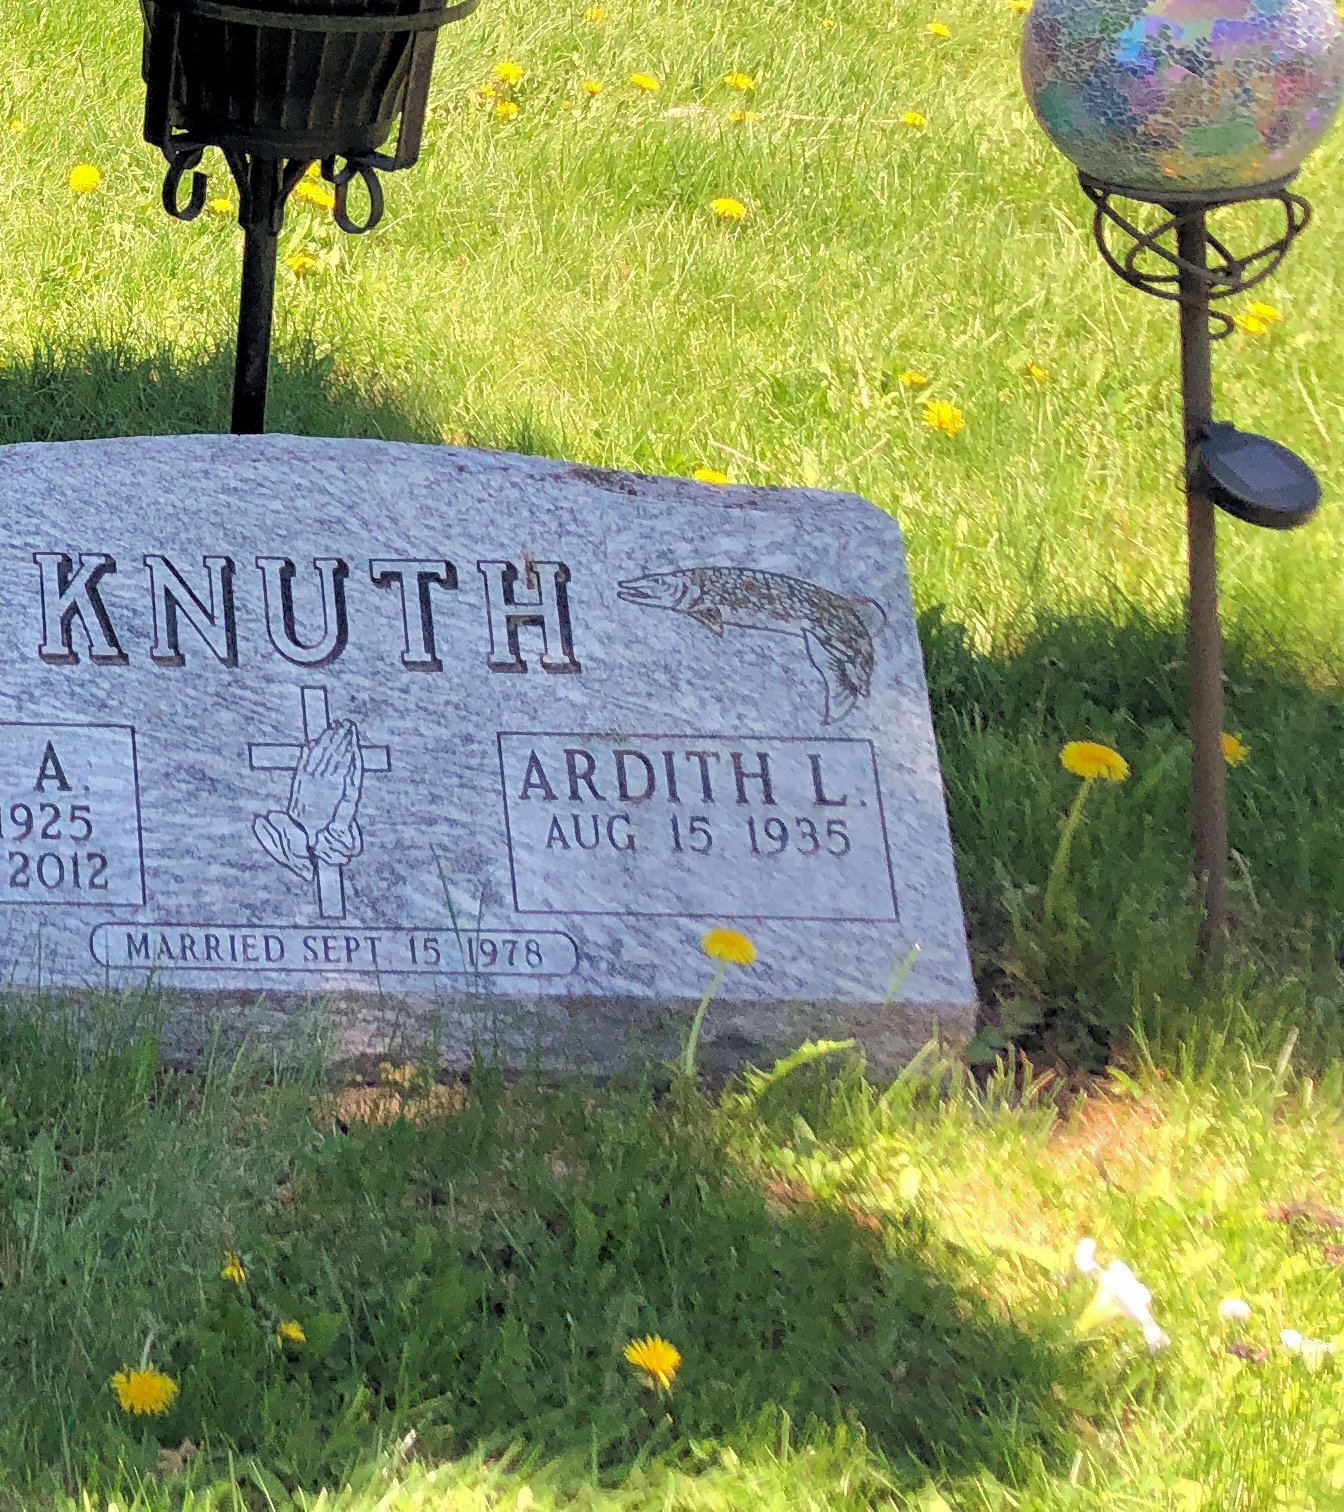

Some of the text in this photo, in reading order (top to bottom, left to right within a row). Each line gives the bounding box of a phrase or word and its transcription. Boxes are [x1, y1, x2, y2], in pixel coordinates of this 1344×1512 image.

[32, 551, 582, 674] KNUTH
[517, 747, 867, 808] ARDITH L.
[746, 815, 852, 858] 1935
[8, 850, 109, 890] 2012
[125, 931, 286, 963] MARRIED
[467, 938, 543, 968] 1978
